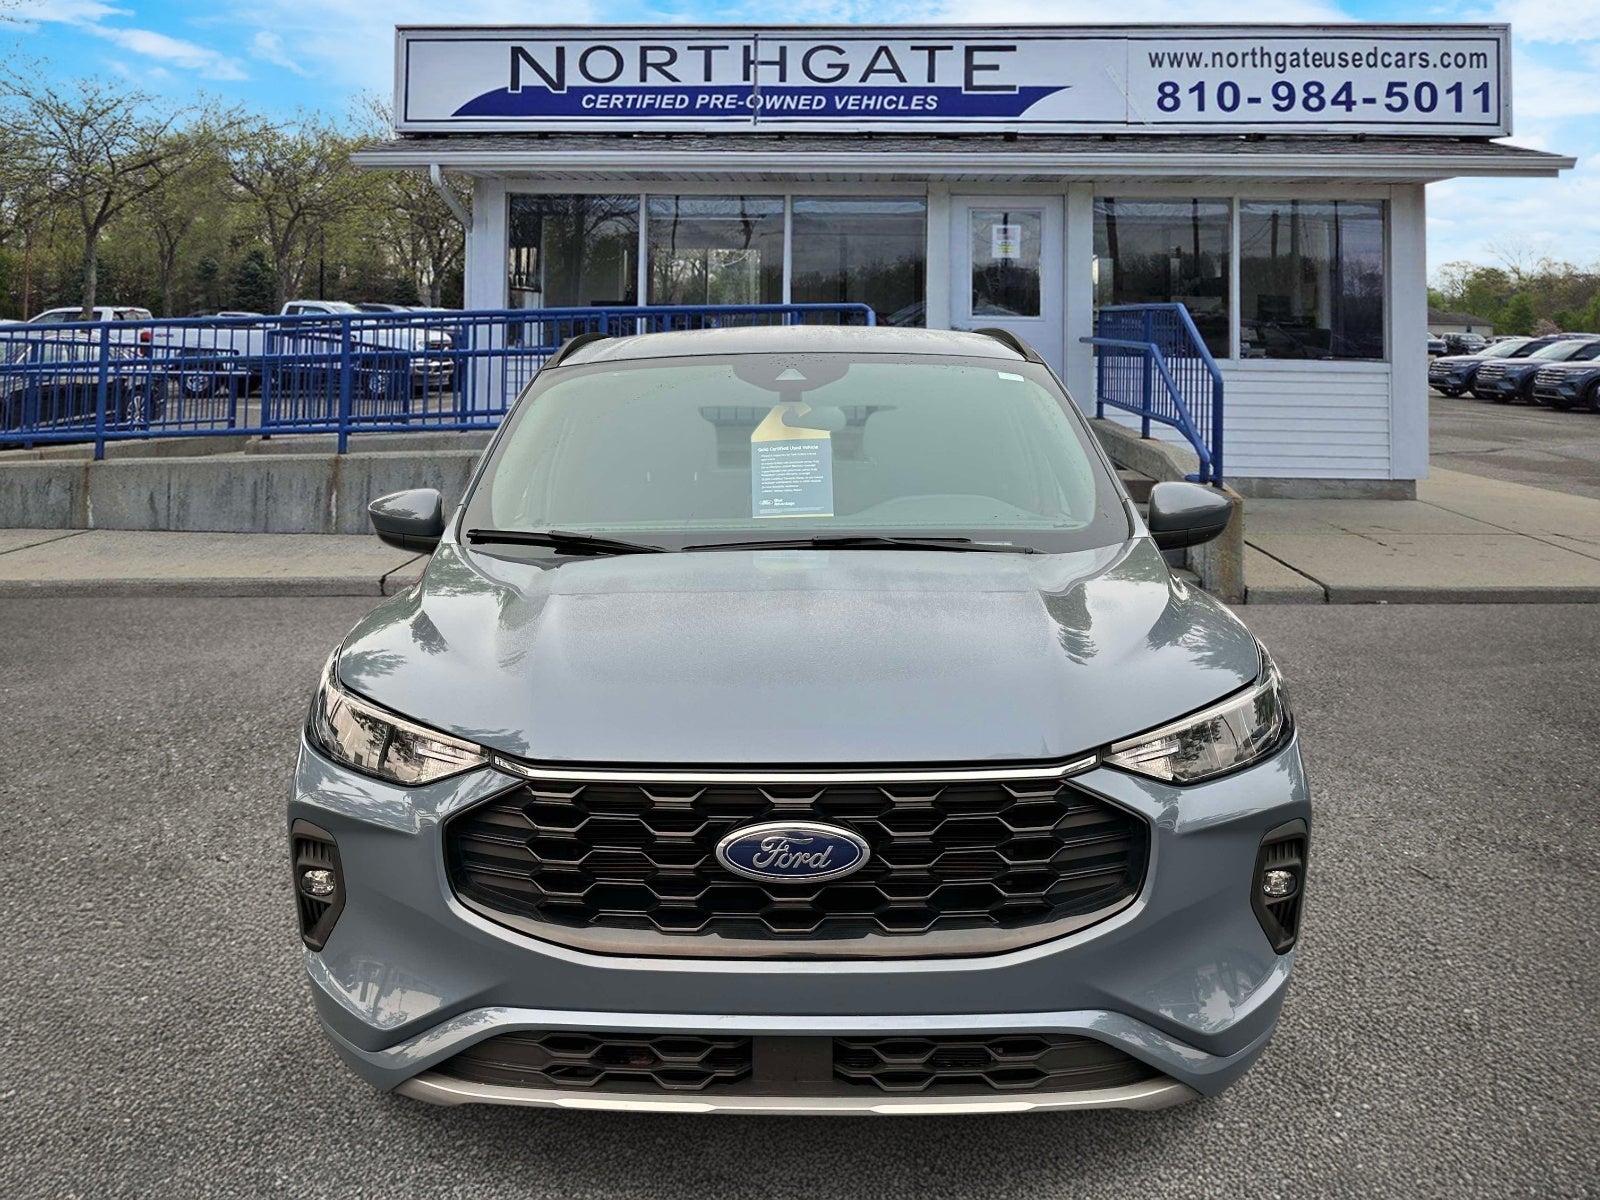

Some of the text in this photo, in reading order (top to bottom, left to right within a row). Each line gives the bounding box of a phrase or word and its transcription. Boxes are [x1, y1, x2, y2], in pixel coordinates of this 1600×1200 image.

[510, 44, 1017, 92] NORTHGATE
[1148, 46, 1488, 73] www.northgateusedcars.com
[581, 94, 938, 110] CERTIFIED PRE-OWNED VEHICLES
[1156, 80, 1492, 112] 810-984-5011
[752, 836, 834, 869] Ford
